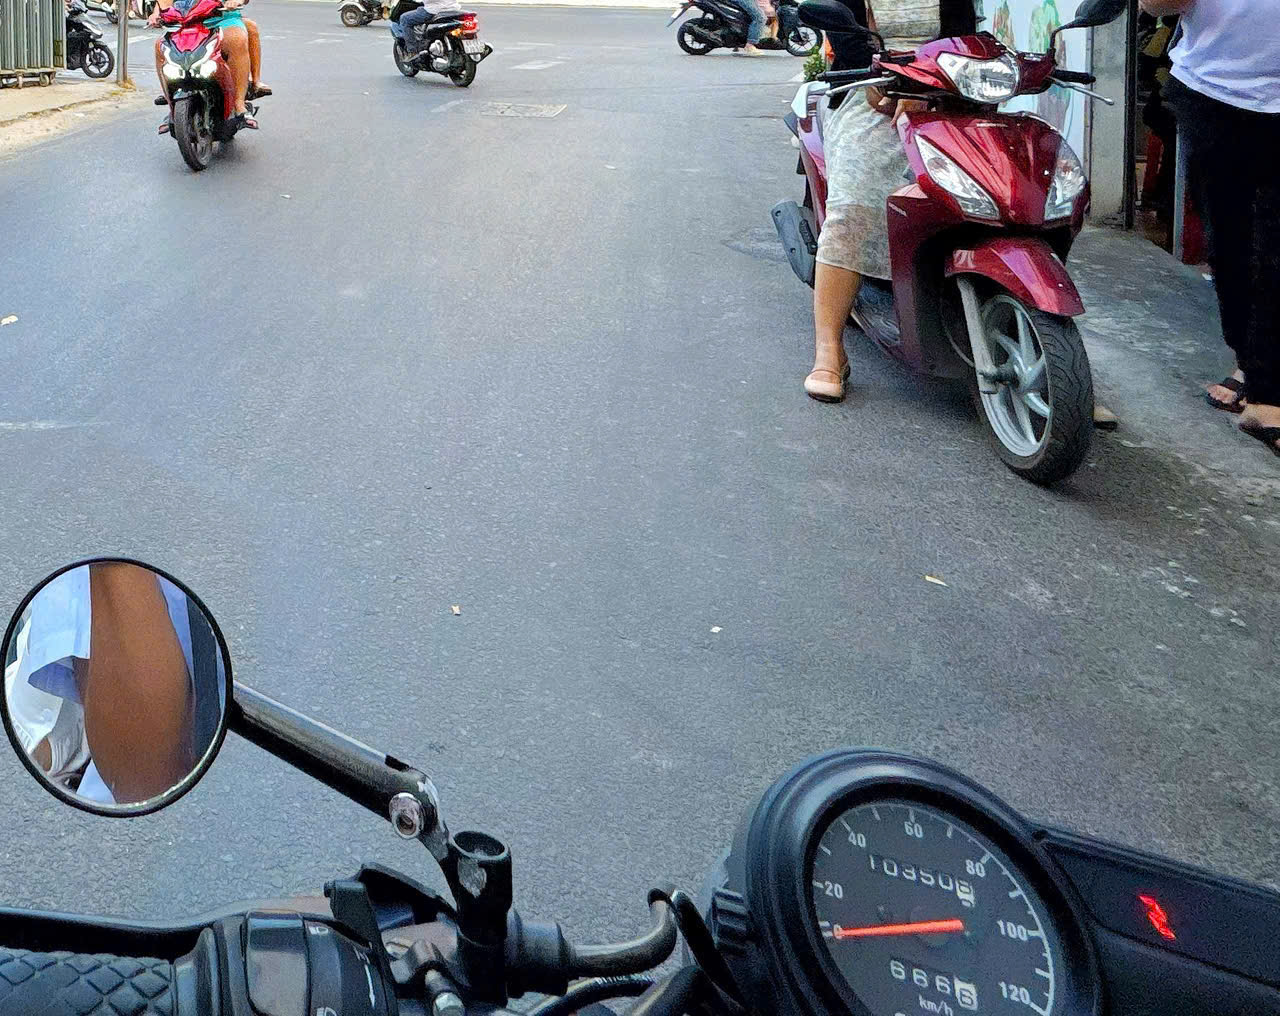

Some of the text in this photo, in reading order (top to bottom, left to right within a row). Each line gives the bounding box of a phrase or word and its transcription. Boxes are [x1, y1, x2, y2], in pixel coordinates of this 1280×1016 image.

[905, 821, 924, 838] 60
[848, 832, 866, 848] 40
[964, 859, 986, 878] 80
[824, 880, 843, 899] 20
[996, 919, 1028, 941] 100
[998, 981, 1030, 1005] 120
[918, 993, 954, 1016] km/h
